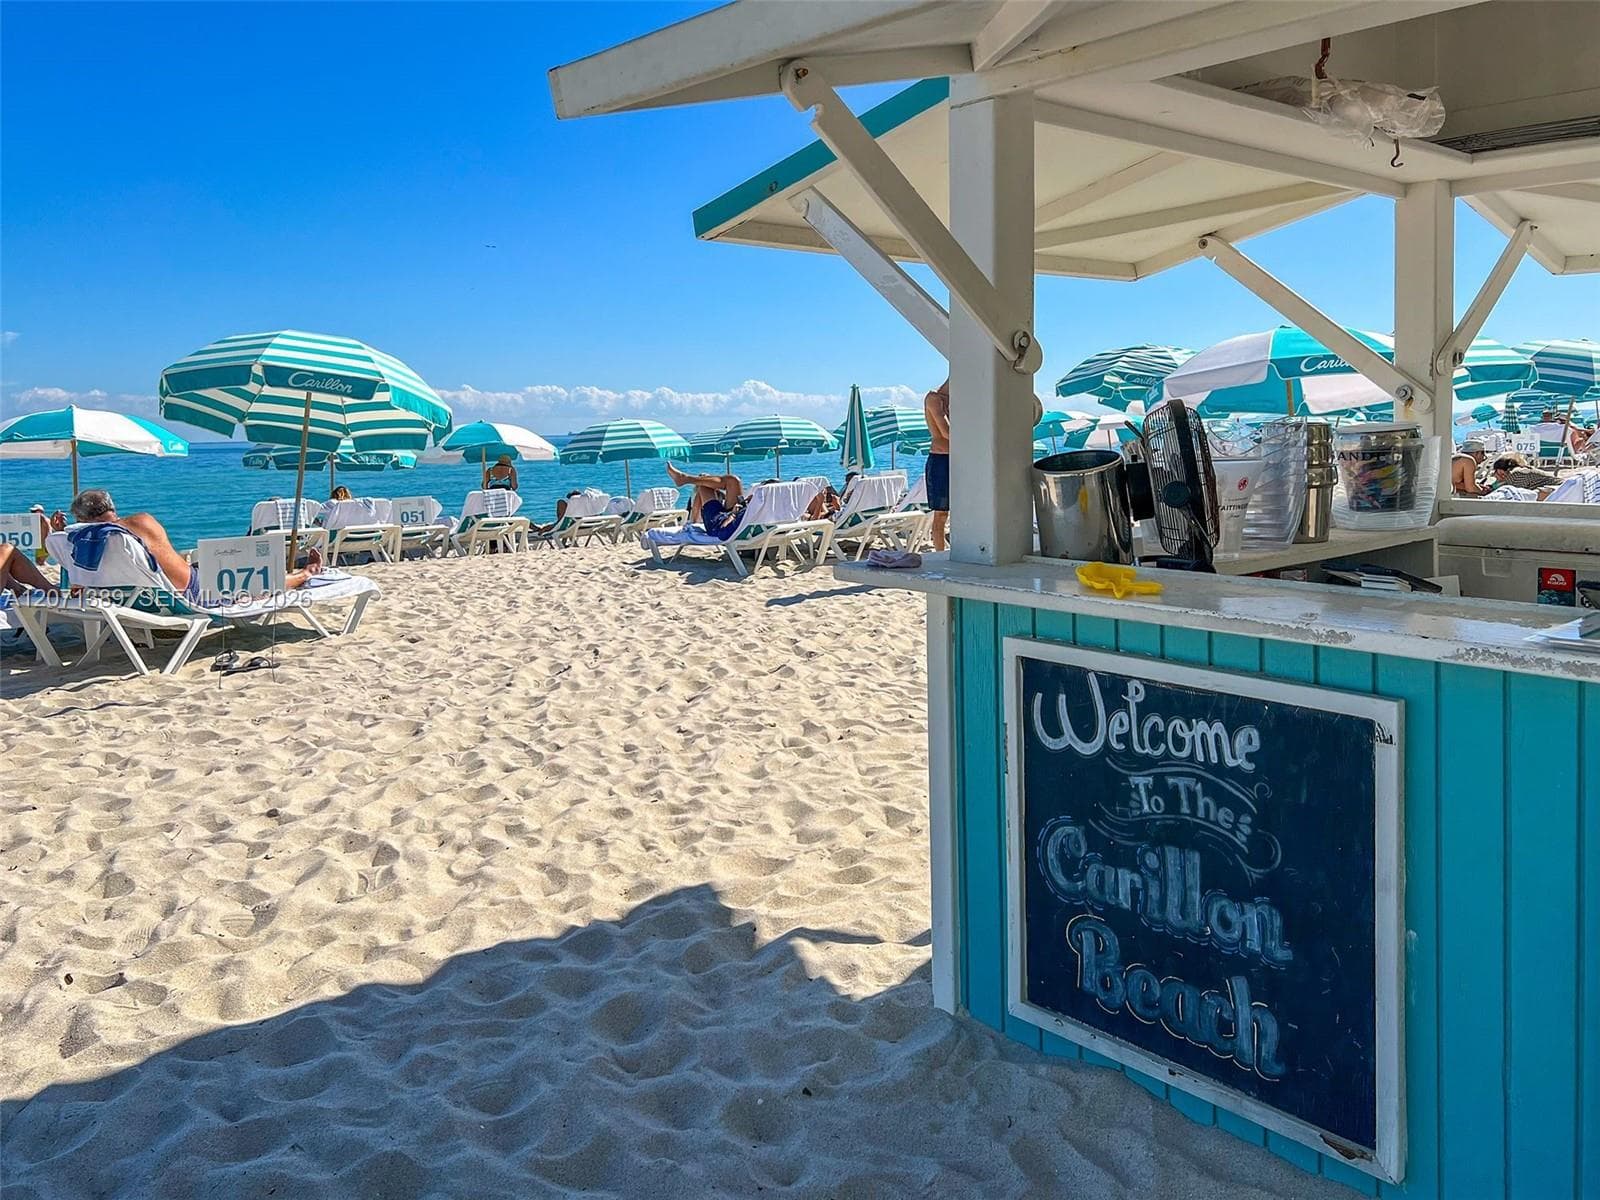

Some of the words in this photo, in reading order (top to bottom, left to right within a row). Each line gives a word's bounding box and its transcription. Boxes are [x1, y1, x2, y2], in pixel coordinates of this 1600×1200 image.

[288, 371, 353, 393] Carillon
[1516, 442, 1536, 451] 075
[400, 510, 425, 523] 051
[217, 566, 270, 593] 071
[1033, 671, 1261, 772] Welcome
[1128, 776, 1165, 814] To
[1164, 776, 1235, 829] The
[1039, 818, 1293, 966] Carillon
[1067, 915, 1285, 1081] Beach
